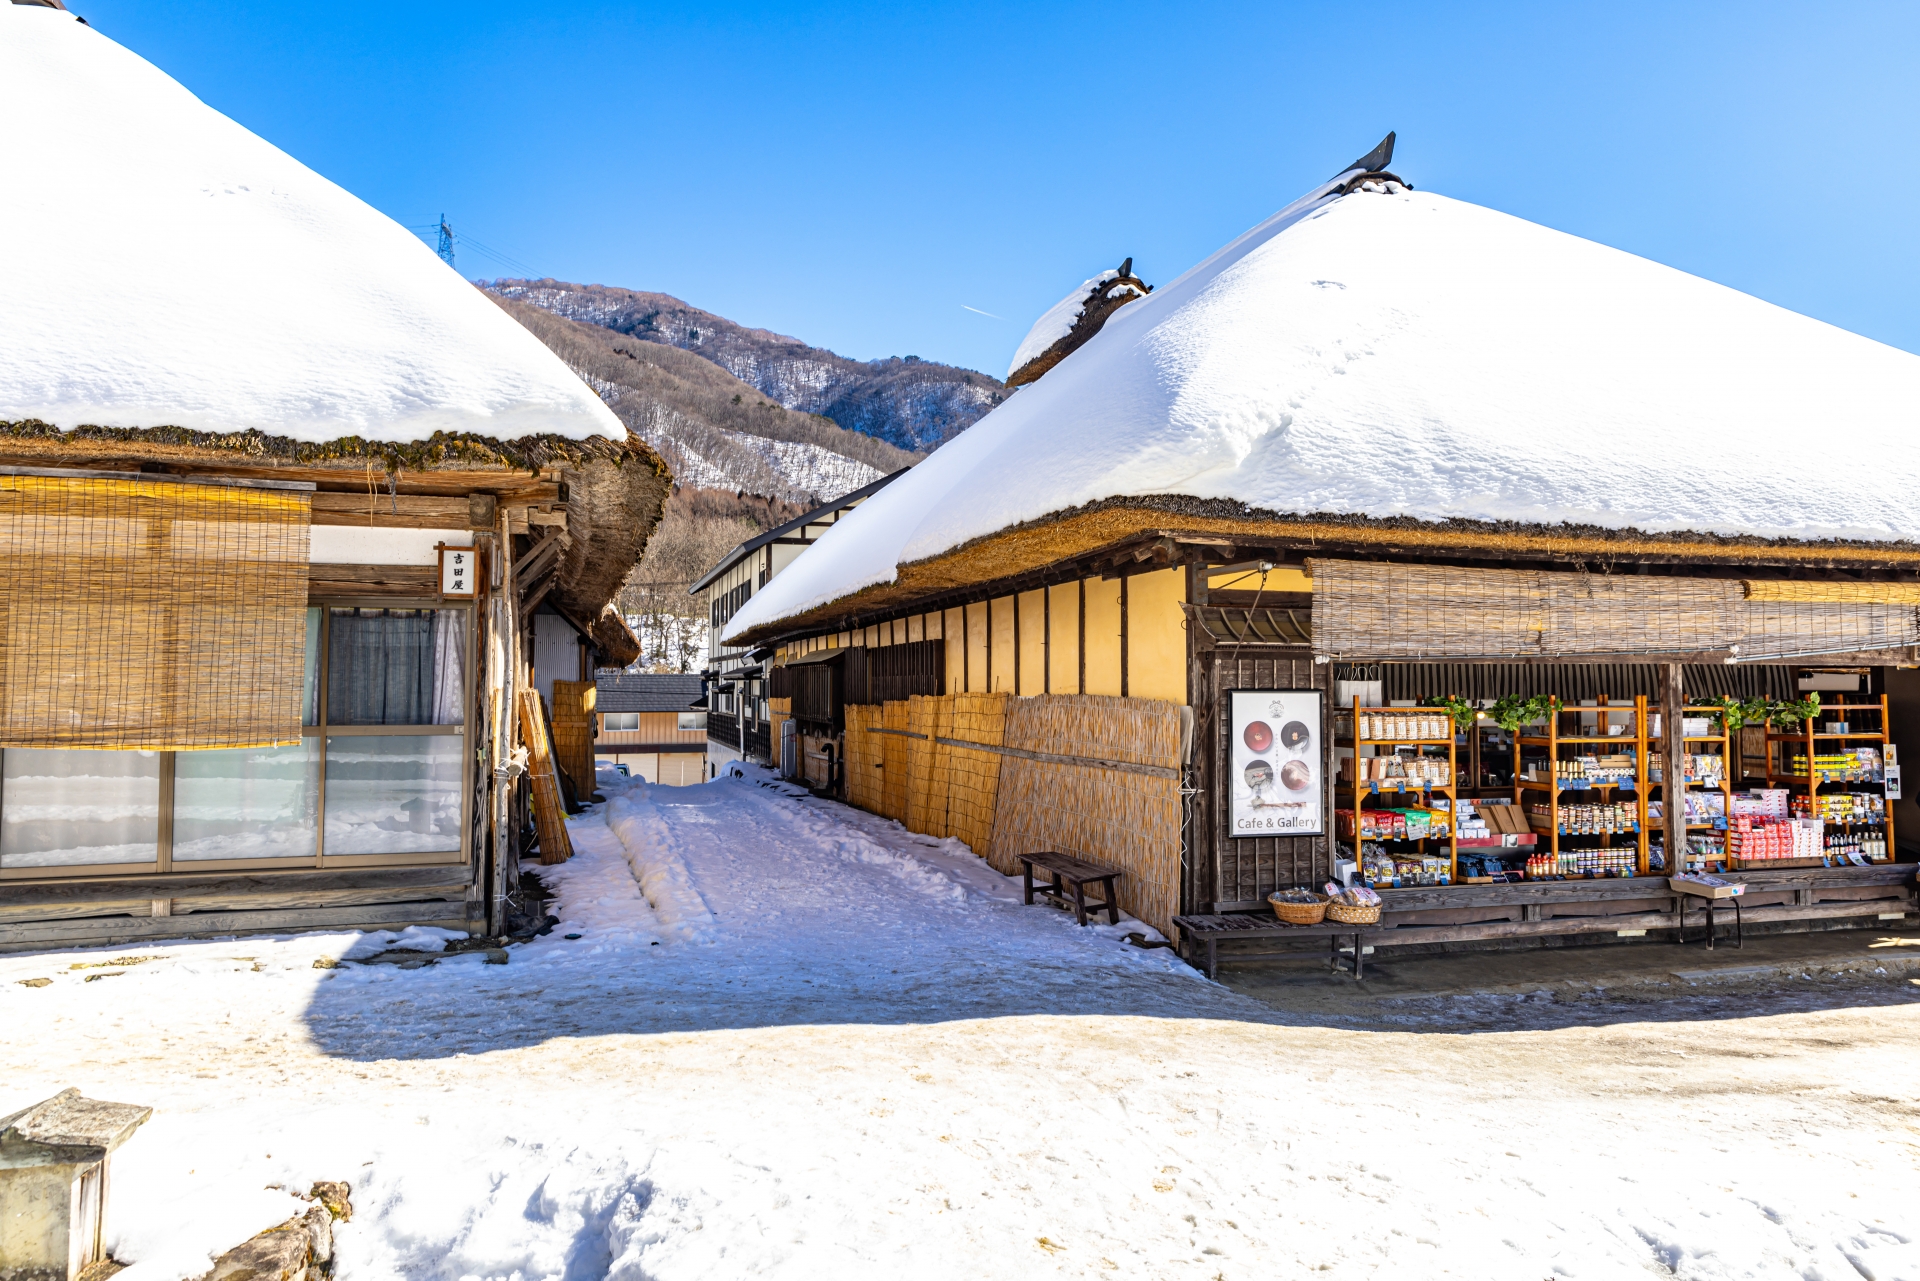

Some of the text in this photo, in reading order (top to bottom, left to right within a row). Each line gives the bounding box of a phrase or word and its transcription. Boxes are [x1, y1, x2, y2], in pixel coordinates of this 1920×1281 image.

[451, 553, 464, 590] 吉田屋
[1237, 816, 1317, 830] Cafe & Gallery
